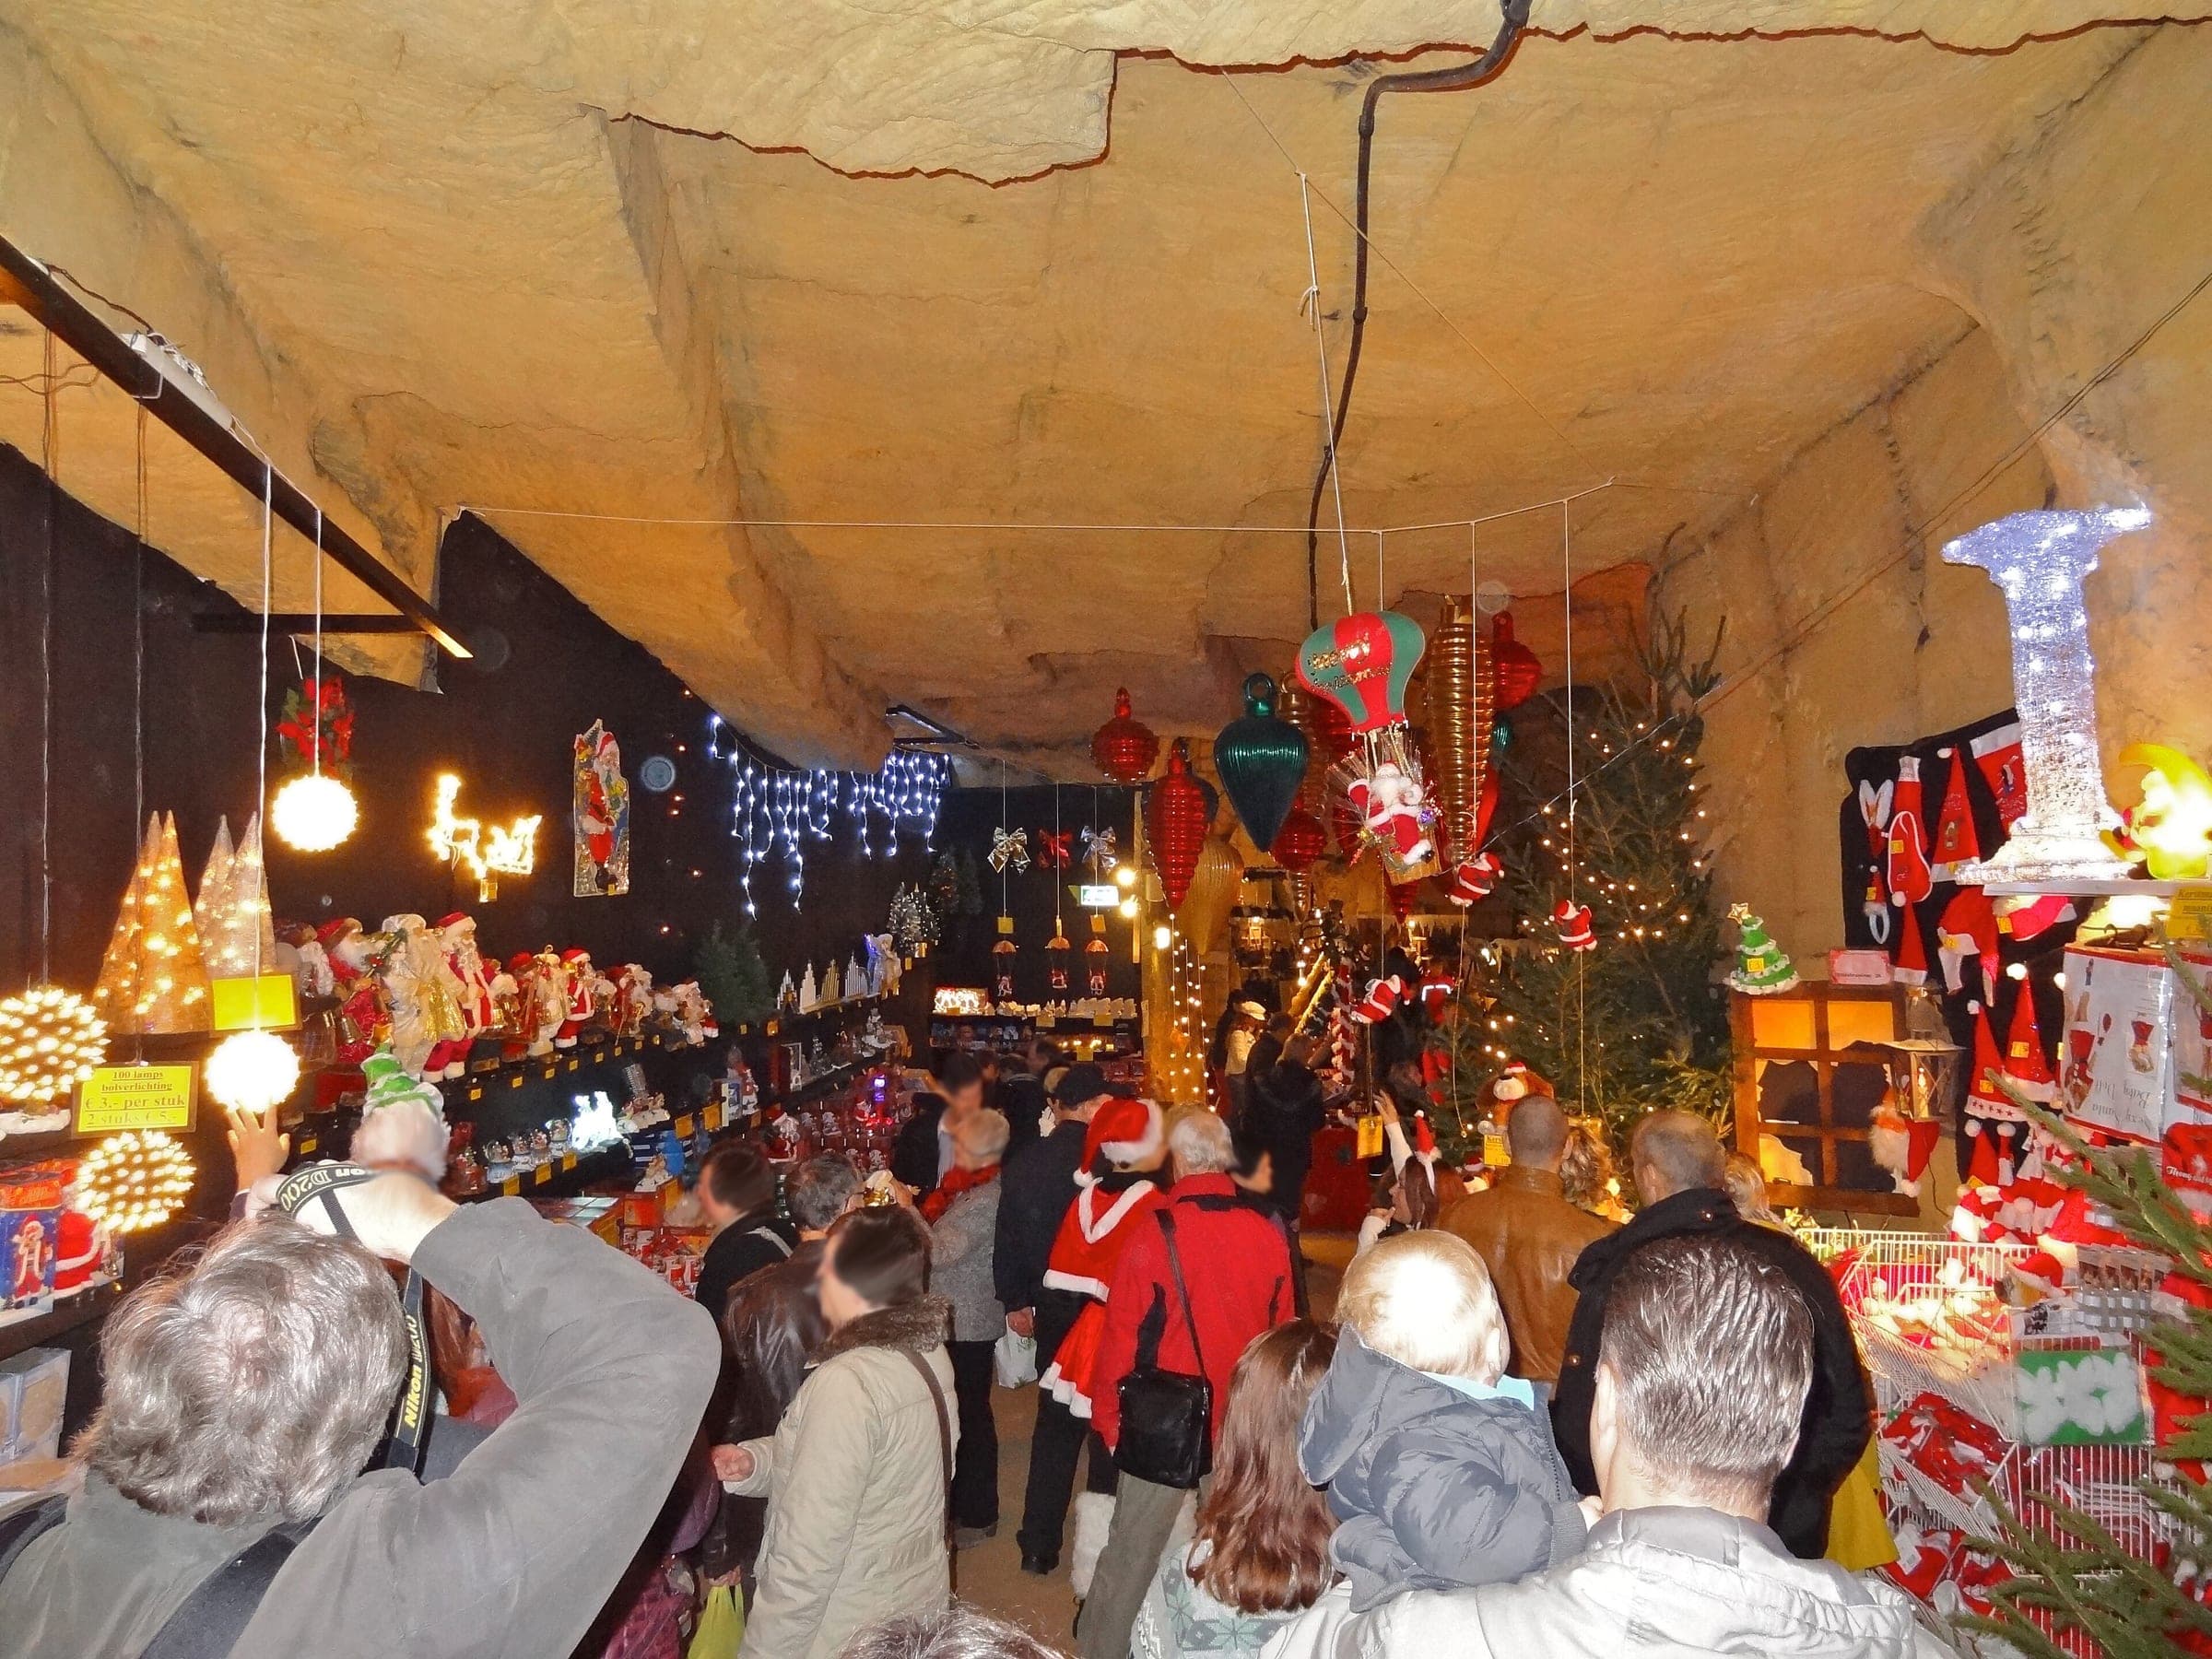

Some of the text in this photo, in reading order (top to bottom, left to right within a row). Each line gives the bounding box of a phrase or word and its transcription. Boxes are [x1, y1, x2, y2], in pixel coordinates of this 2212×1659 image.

[113, 1070, 163, 1079] 100 lamps
[124, 1098, 149, 1110] per
[154, 1094, 185, 1106] stuk
[280, 1169, 333, 1212] D200
[404, 1364, 422, 1428] Nikon
